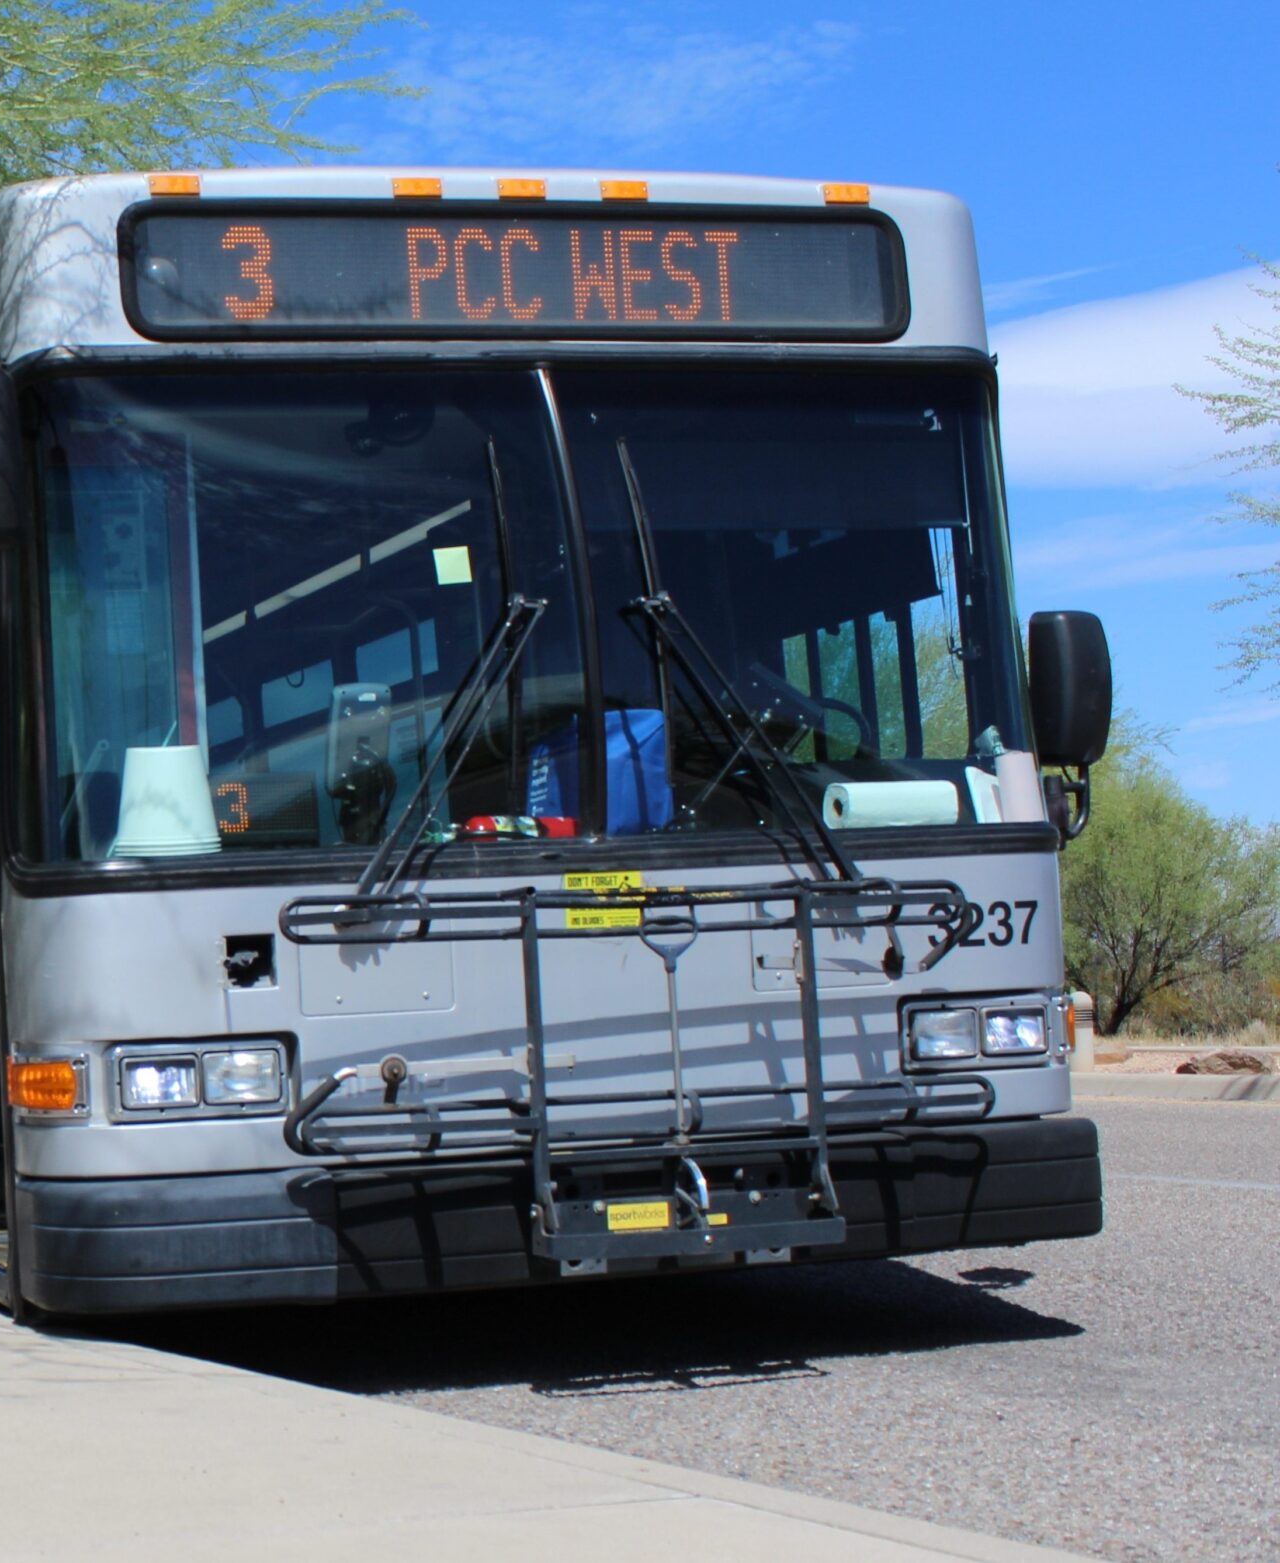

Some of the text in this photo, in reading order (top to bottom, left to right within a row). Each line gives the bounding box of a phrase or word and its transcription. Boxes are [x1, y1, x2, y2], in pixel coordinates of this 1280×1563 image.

[220, 225, 739, 322] 3 PCC WEST
[217, 782, 250, 833] 3
[567, 875, 618, 888] DON'T FORGET
[927, 900, 1038, 947] 3237
